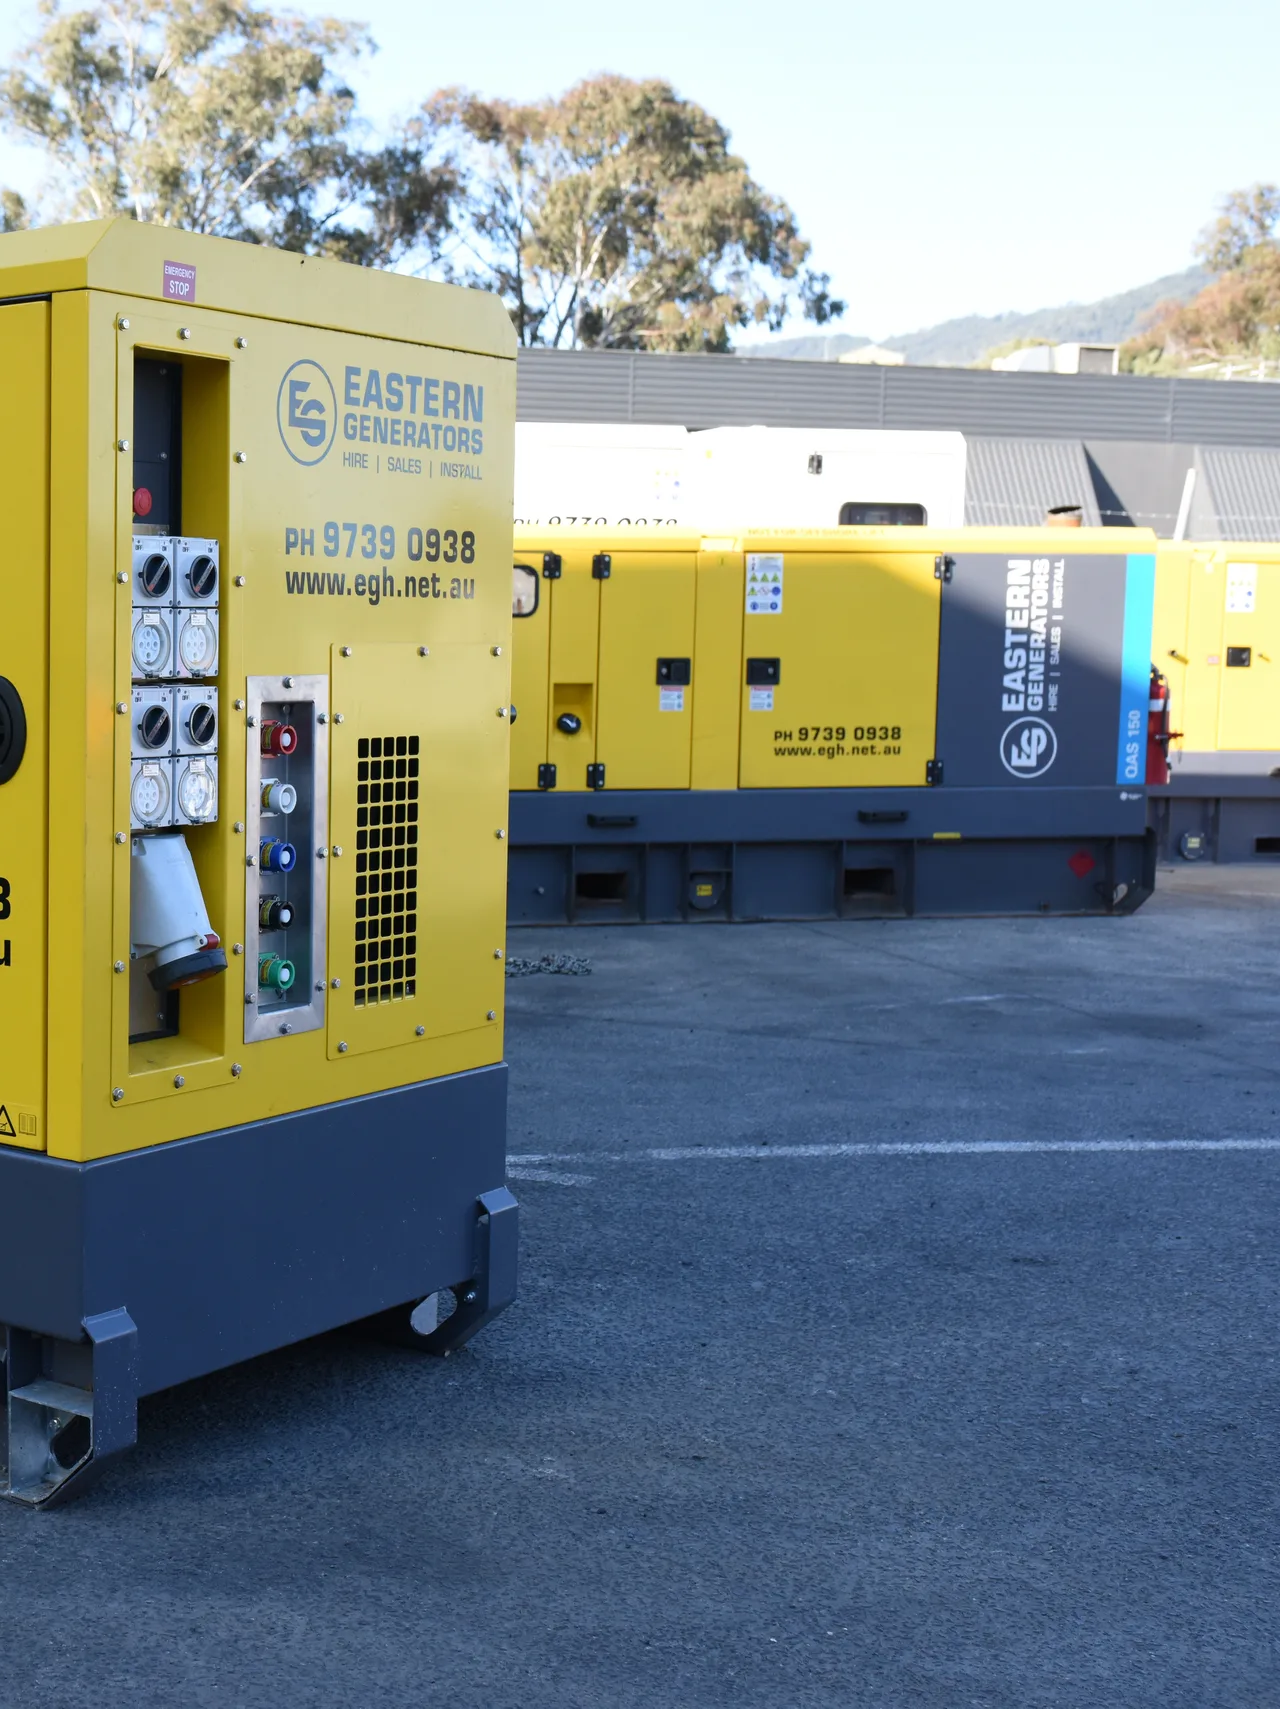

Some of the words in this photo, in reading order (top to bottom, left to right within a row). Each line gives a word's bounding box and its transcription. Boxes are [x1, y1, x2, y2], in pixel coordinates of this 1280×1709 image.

[165, 265, 195, 279] EMERGENCY
[169, 280, 190, 296] STOP
[344, 365, 484, 423] EASTERN
[343, 412, 483, 455] GENERATORS
[343, 452, 369, 469] HIRE
[387, 456, 422, 475] SALES
[440, 462, 483, 481] INSTALL
[285, 527, 315, 556] PH
[323, 521, 395, 560] 9739
[407, 527, 475, 564] 0938
[285, 566, 475, 606] www.egh.net.au
[1052, 558, 1065, 609] INSTALL
[1002, 559, 1031, 712] EASTERN
[1027, 558, 1050, 712] GENERATORS
[1050, 626, 1062, 665] SALES
[1048, 683, 1059, 712] HIRE
[774, 730, 793, 741] PH
[798, 726, 846, 741] 9739
[854, 726, 901, 741] 0938
[1128, 709, 1141, 736] 150
[774, 743, 901, 759] www.egh.net.au
[1125, 742, 1140, 779] QAS
